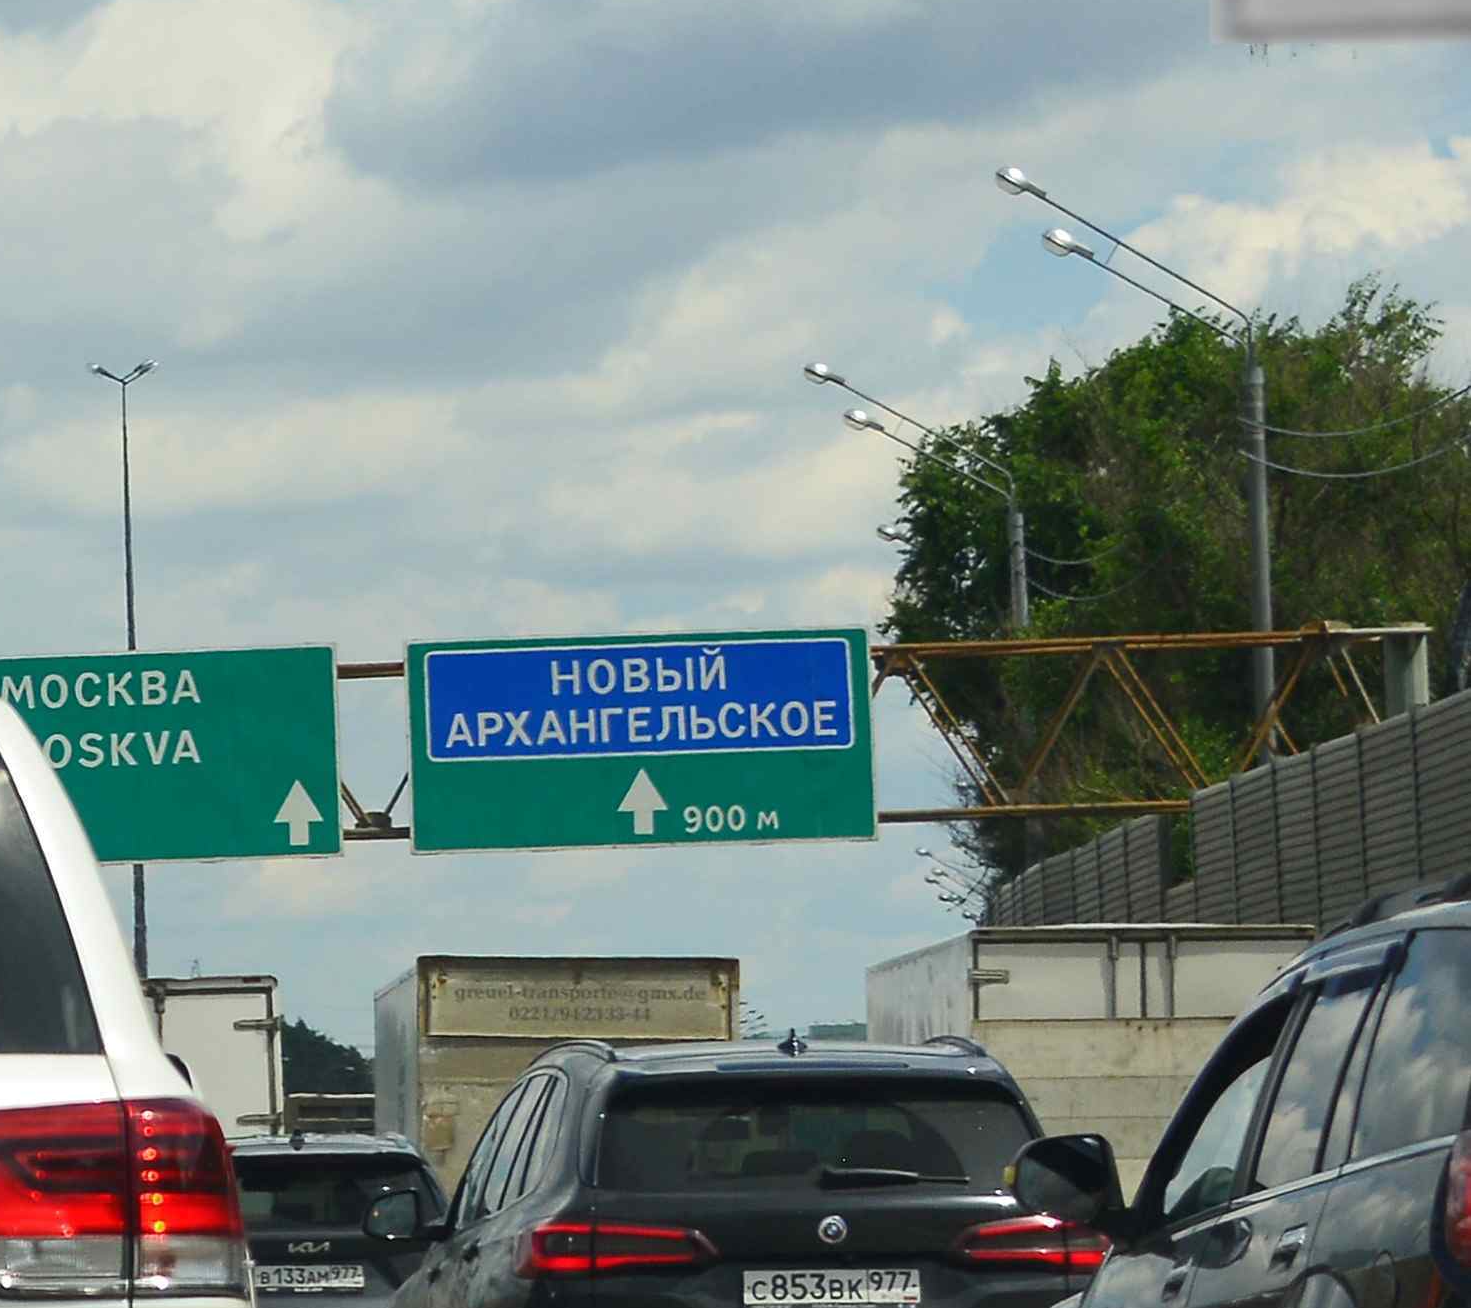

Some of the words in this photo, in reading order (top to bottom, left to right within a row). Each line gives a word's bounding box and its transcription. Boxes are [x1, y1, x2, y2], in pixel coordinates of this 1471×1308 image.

[0, 669, 202, 710] МОСКВА
[550, 646, 727, 696] НОВЫЙ
[445, 699, 838, 748] АРХАНГЕЛЬСКОЕ
[40, 729, 202, 771] OSKVA
[683, 804, 746, 833] 900
[869, 1271, 912, 1292] 977
